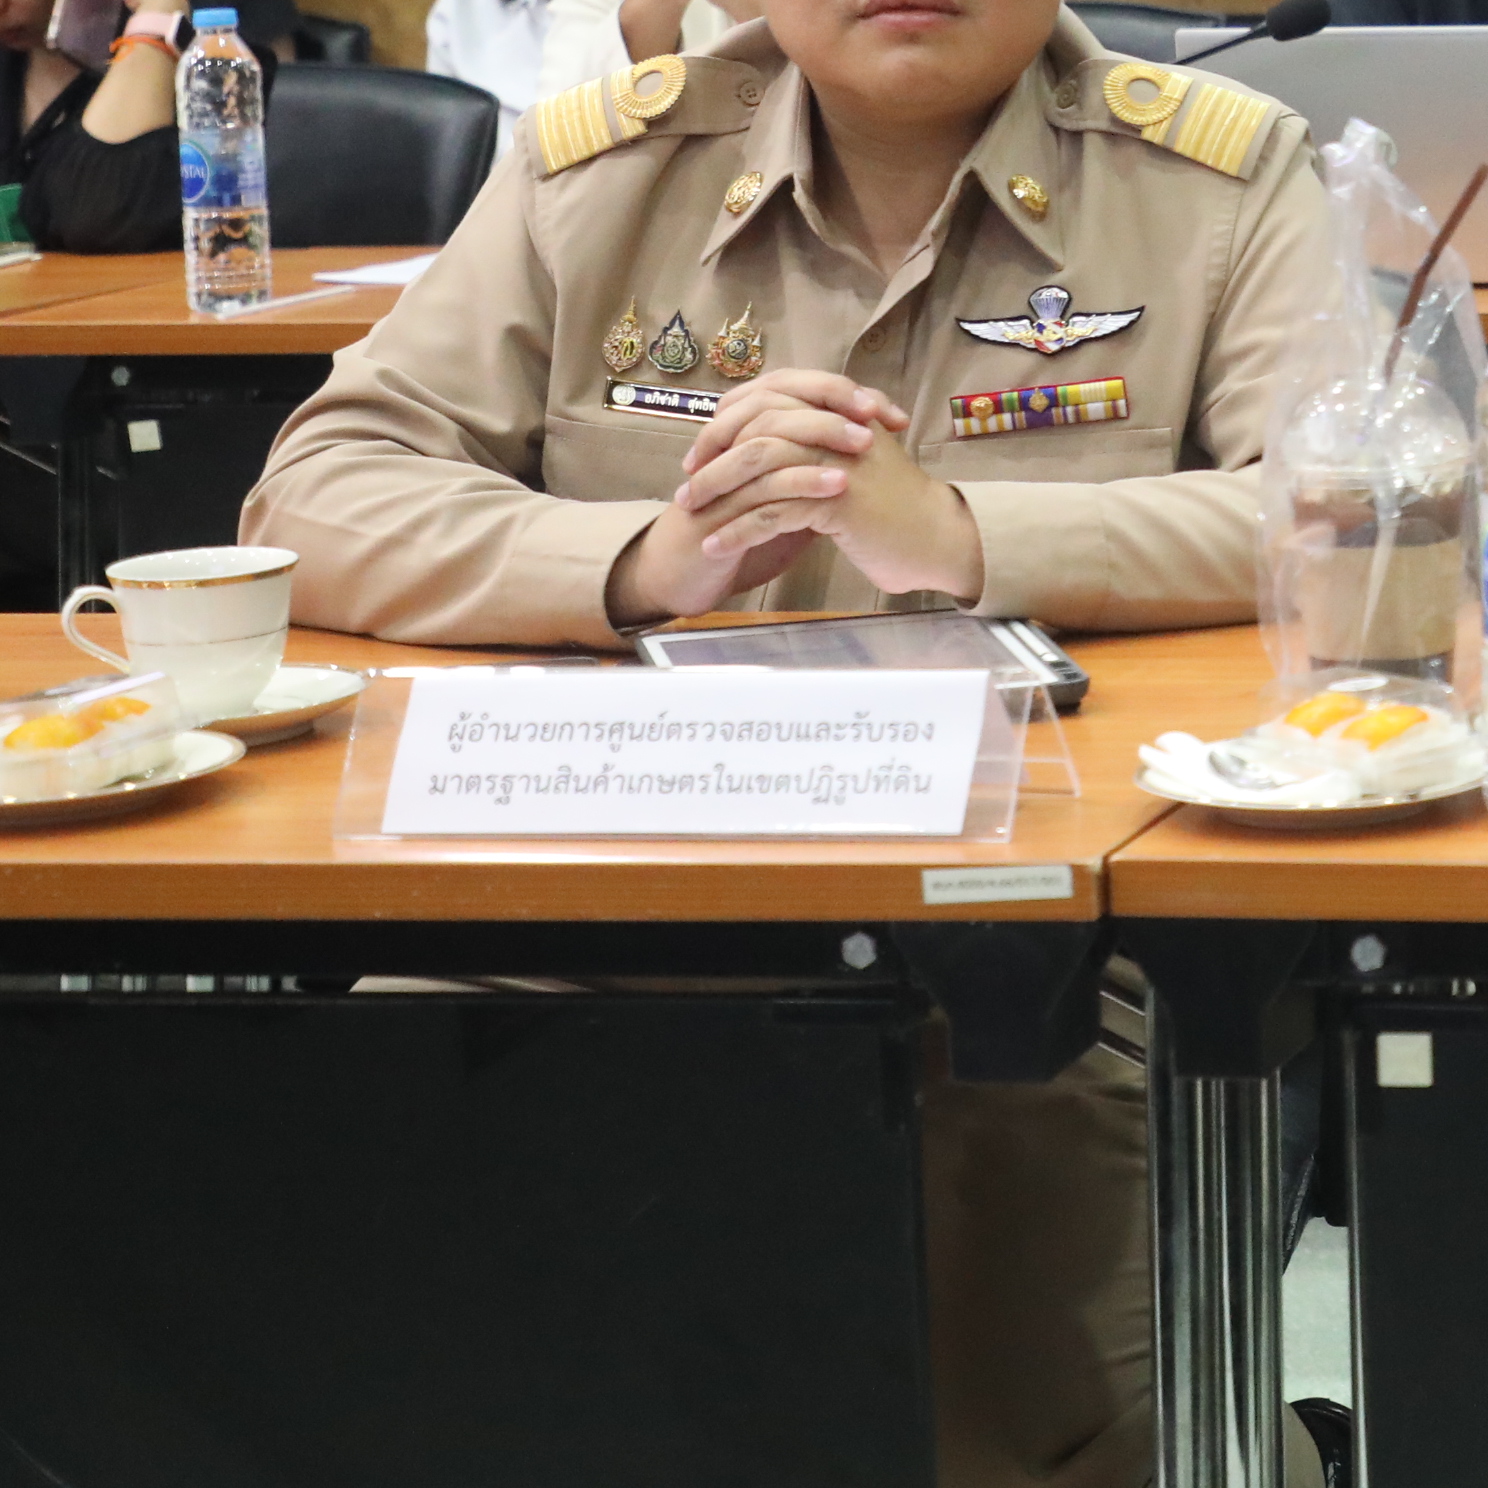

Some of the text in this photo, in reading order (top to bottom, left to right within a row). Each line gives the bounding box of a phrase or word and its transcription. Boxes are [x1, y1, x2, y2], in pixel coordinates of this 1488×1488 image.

[448, 710, 936, 754] ผู้อำนวยการศูนย์ตรวจสอบและรับรอง
[428, 758, 932, 806] มาตรฐานสินค้าเกษตรในเขตปฏิรูปที่ดิน
